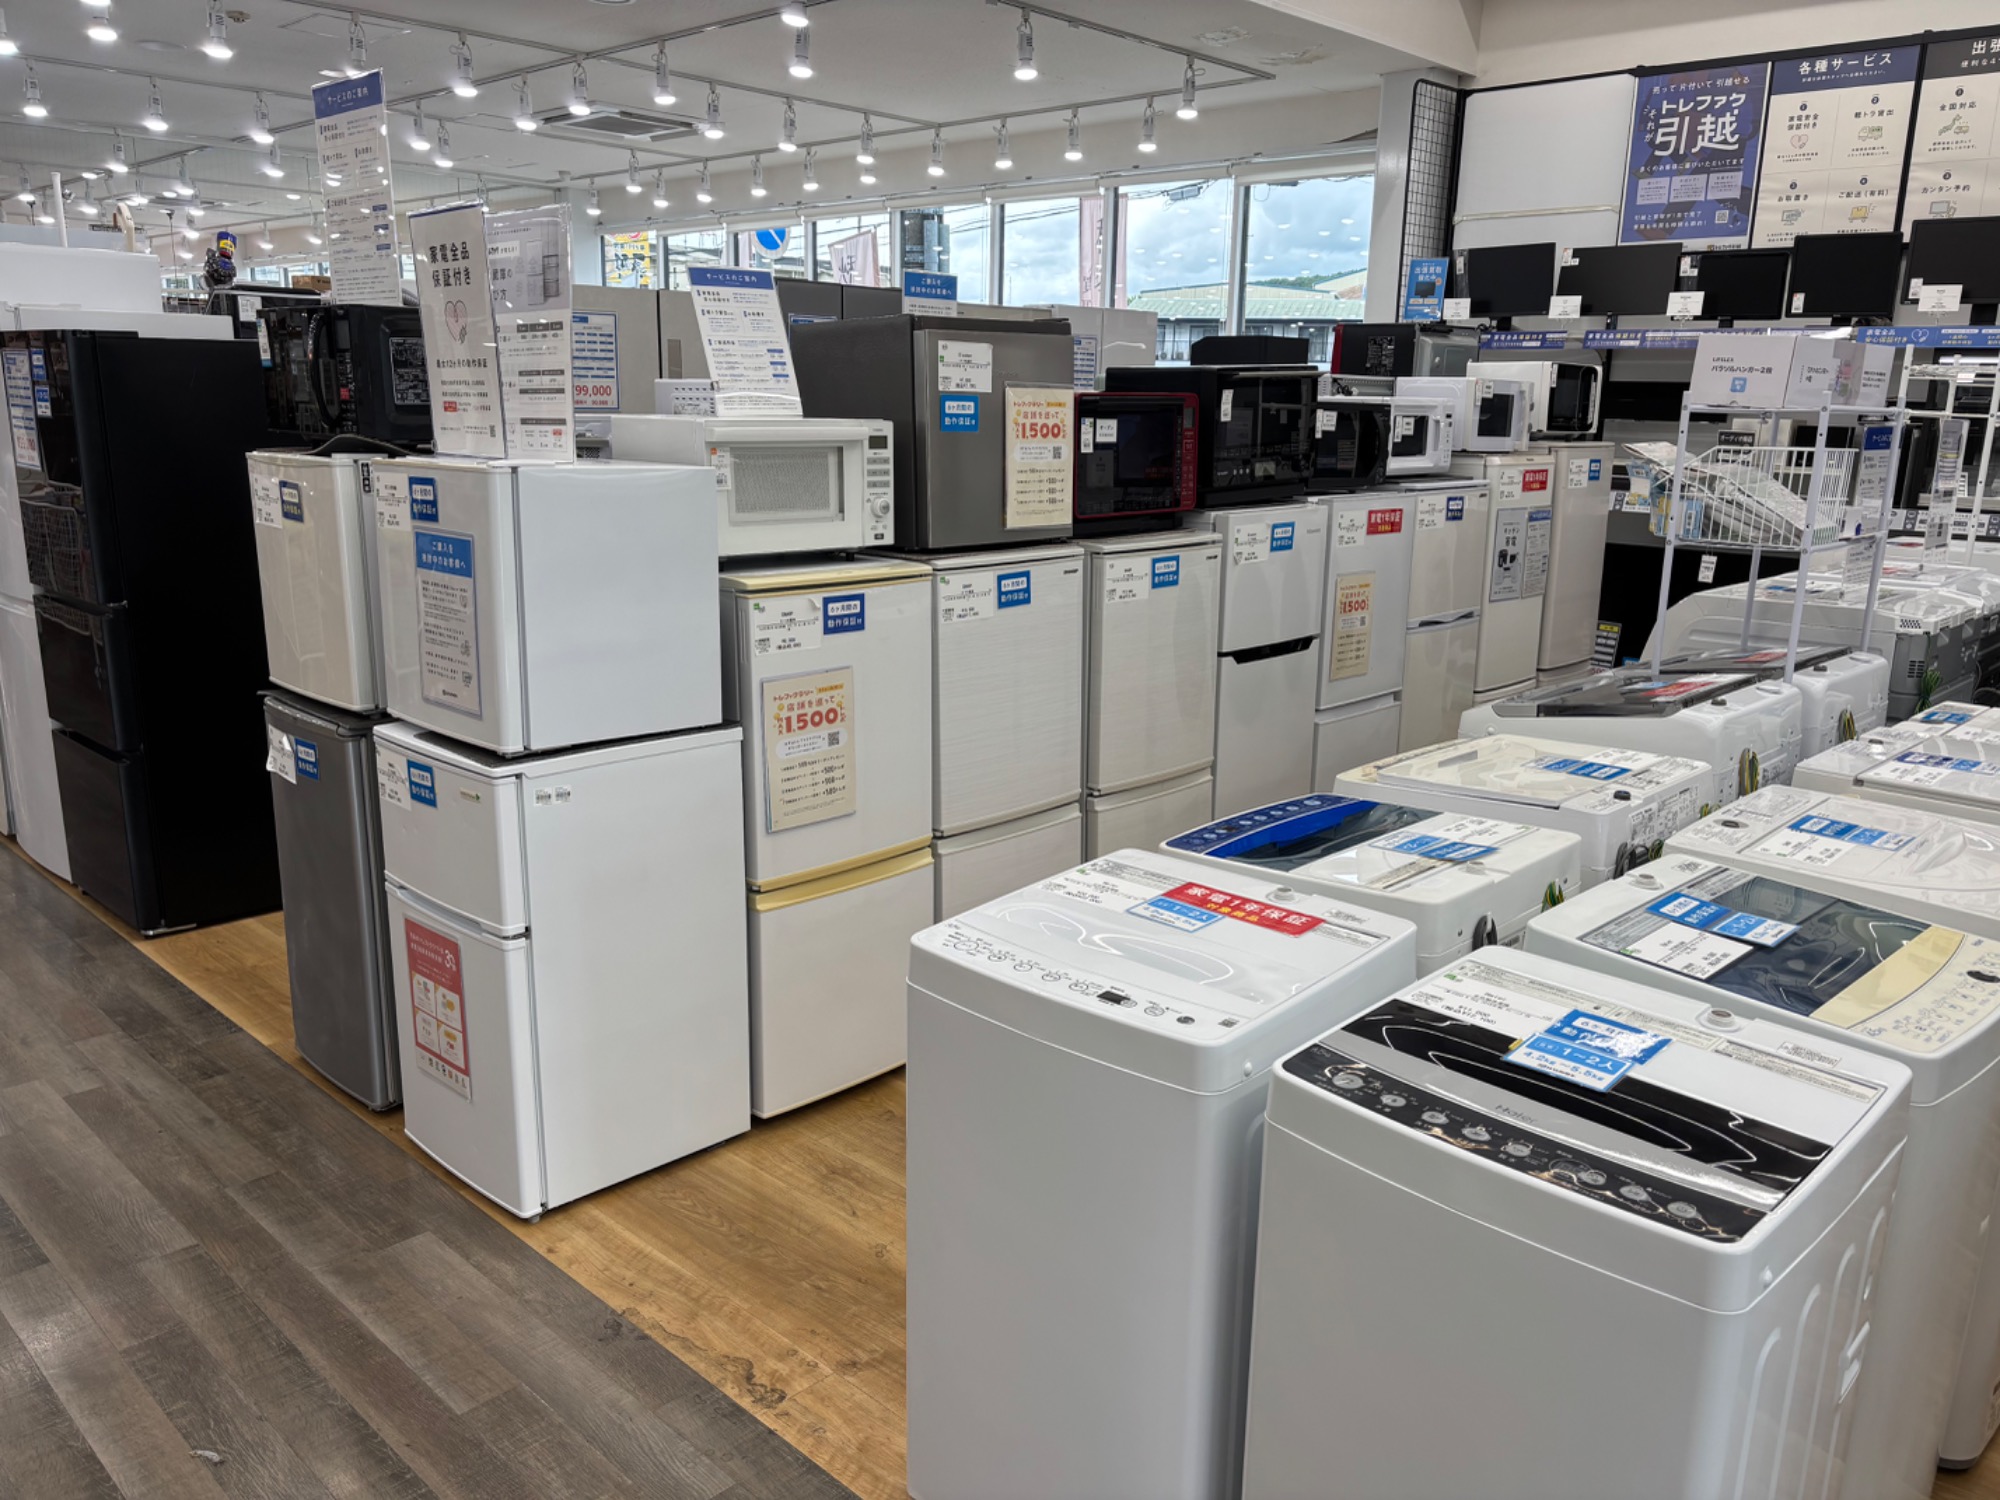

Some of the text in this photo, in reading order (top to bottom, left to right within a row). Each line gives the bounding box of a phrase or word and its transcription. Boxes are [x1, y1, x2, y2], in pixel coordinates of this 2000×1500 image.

[1799, 52, 1893, 75] 各種サービス
[1661, 93, 1747, 115] トレファク
[1939, 102, 1976, 112] 全国対応
[1654, 112, 1740, 156] 引越
[1922, 184, 1971, 195] カンタン予約
[429, 242, 470, 264] 家電全品
[432, 266, 472, 288] 保証付き
[706, 273, 757, 283] サービスのご案内
[575, 385, 612, 398] 99,000
[1020, 422, 1062, 440] 1,500
[830, 603, 858, 614] 6ヶ月間の
[827, 616, 862, 628] 動作保証付
[784, 707, 839, 734] 1,500
[1185, 885, 1312, 926] 家電1年保証
[1205, 902, 1259, 922] 対象商品
[1562, 1048, 1613, 1071] 1～2人
[1495, 1104, 1539, 1125] Haier
